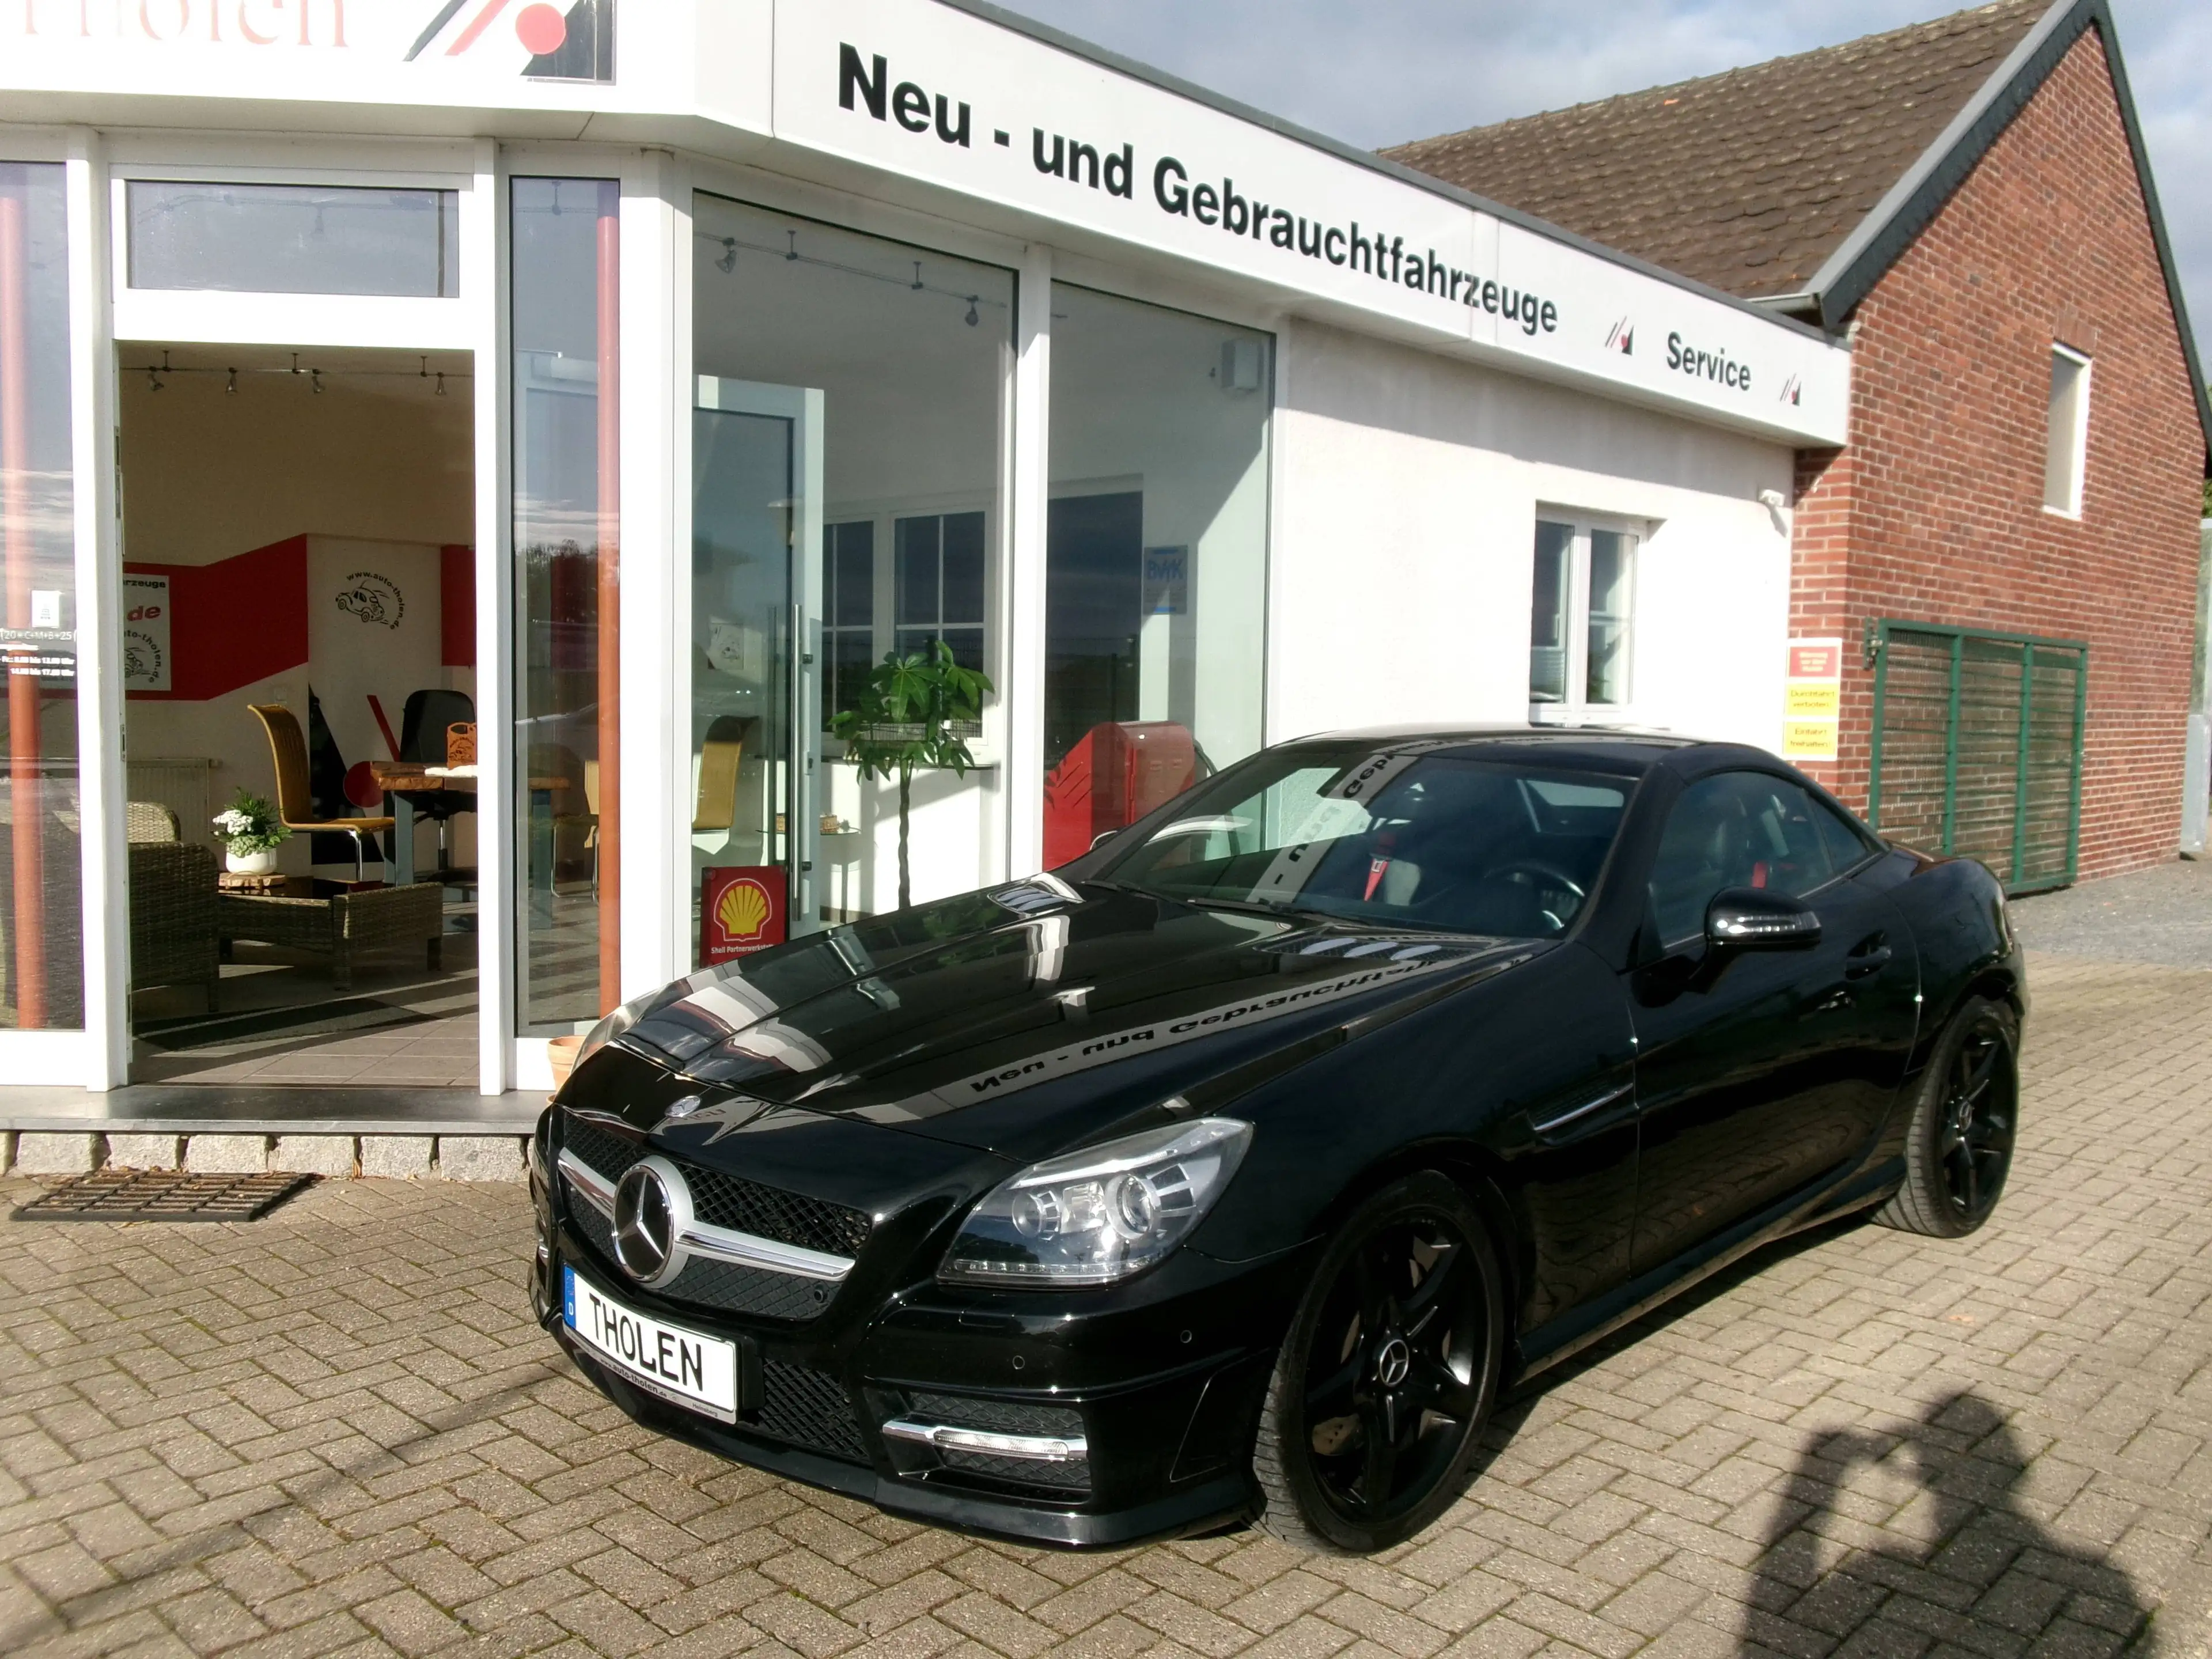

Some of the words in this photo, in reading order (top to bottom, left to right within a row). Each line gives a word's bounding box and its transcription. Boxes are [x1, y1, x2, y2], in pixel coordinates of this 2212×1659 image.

[839, 41, 971, 148] Neu
[1033, 127, 1134, 200] und
[1153, 156, 1558, 336] Gebrauchtfahrzeuge
[1666, 331, 1752, 391] Service
[346, 571, 405, 630] www.auto-tholen.de
[727, 944, 774, 953] Partnerwerkst
[589, 1291, 703, 1392] THOLEN
[600, 1358, 668, 1398] www.auto-tholen.de
